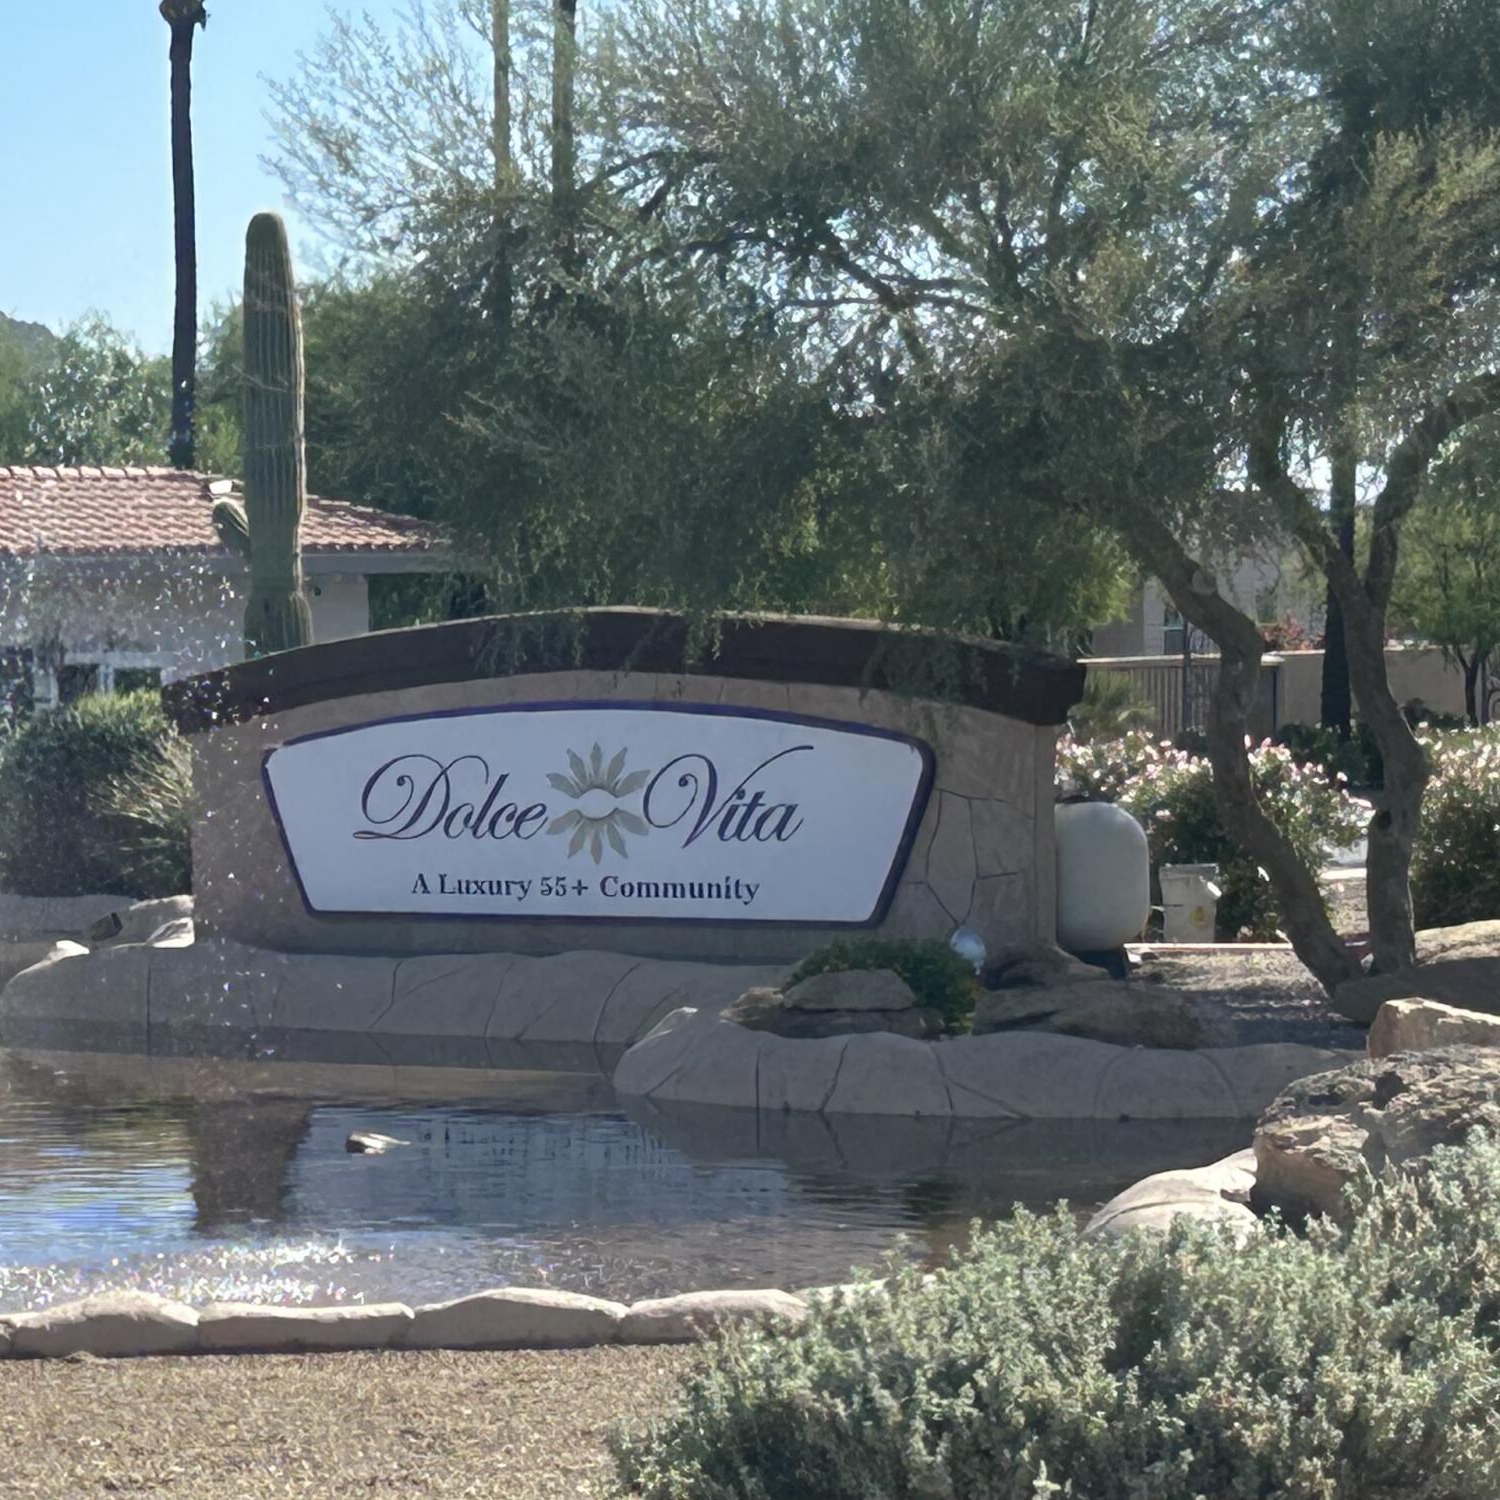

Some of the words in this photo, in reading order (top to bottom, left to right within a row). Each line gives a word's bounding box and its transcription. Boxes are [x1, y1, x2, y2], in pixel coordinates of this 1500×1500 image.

[353, 753, 549, 841] Dolce
[642, 745, 815, 849] Vita
[411, 873, 431, 895] A
[438, 873, 532, 901] Luxury
[540, 875, 589, 897] 55+
[599, 875, 761, 905] Community
